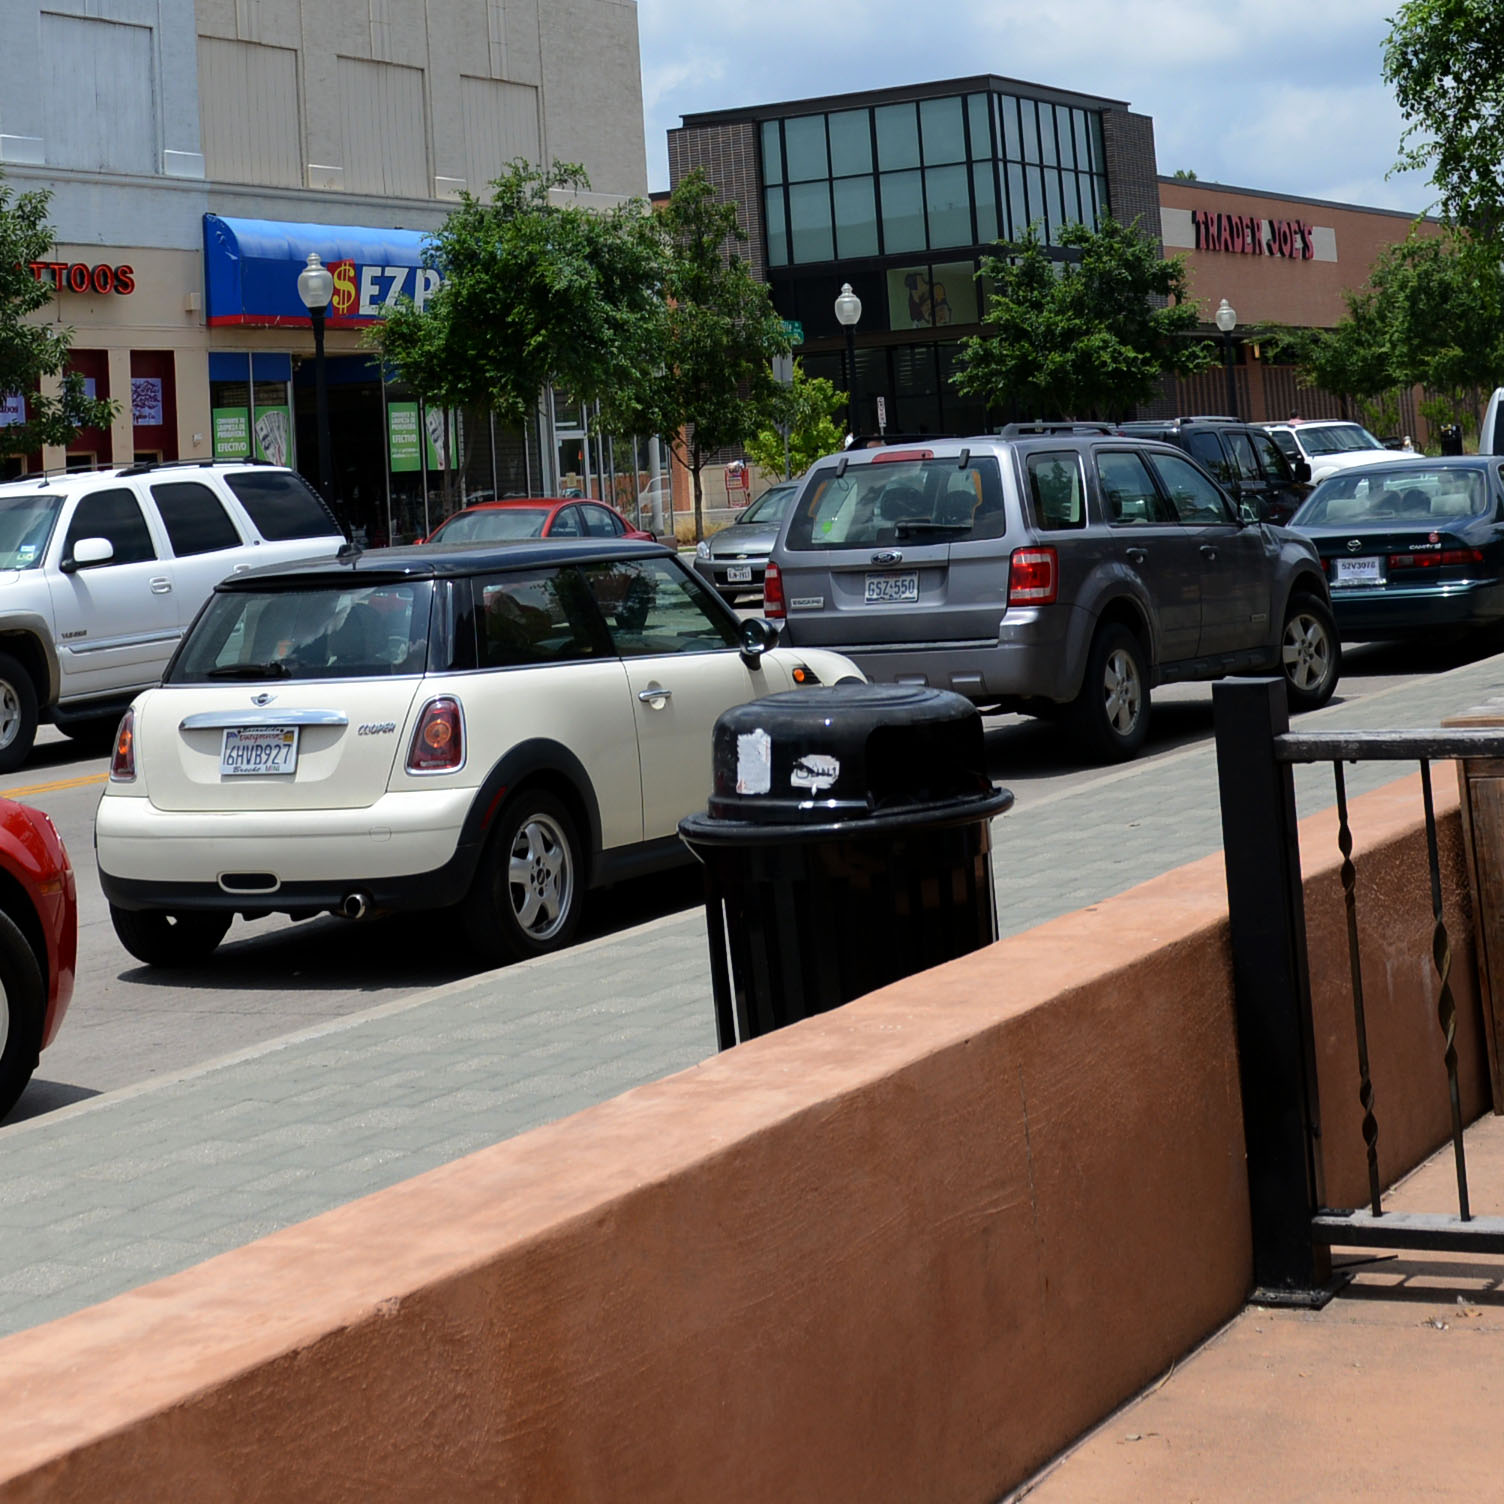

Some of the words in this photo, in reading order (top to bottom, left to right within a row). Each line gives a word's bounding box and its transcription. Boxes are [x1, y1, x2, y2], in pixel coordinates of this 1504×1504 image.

[1193, 210, 1265, 255] TRADER
[1267, 219, 1314, 260] JOE'S
[15, 260, 136, 295] TTOOS
[359, 266, 410, 315] EZ
[357, 722, 397, 736] COOPER
[226, 744, 292, 766] 6HVB927
